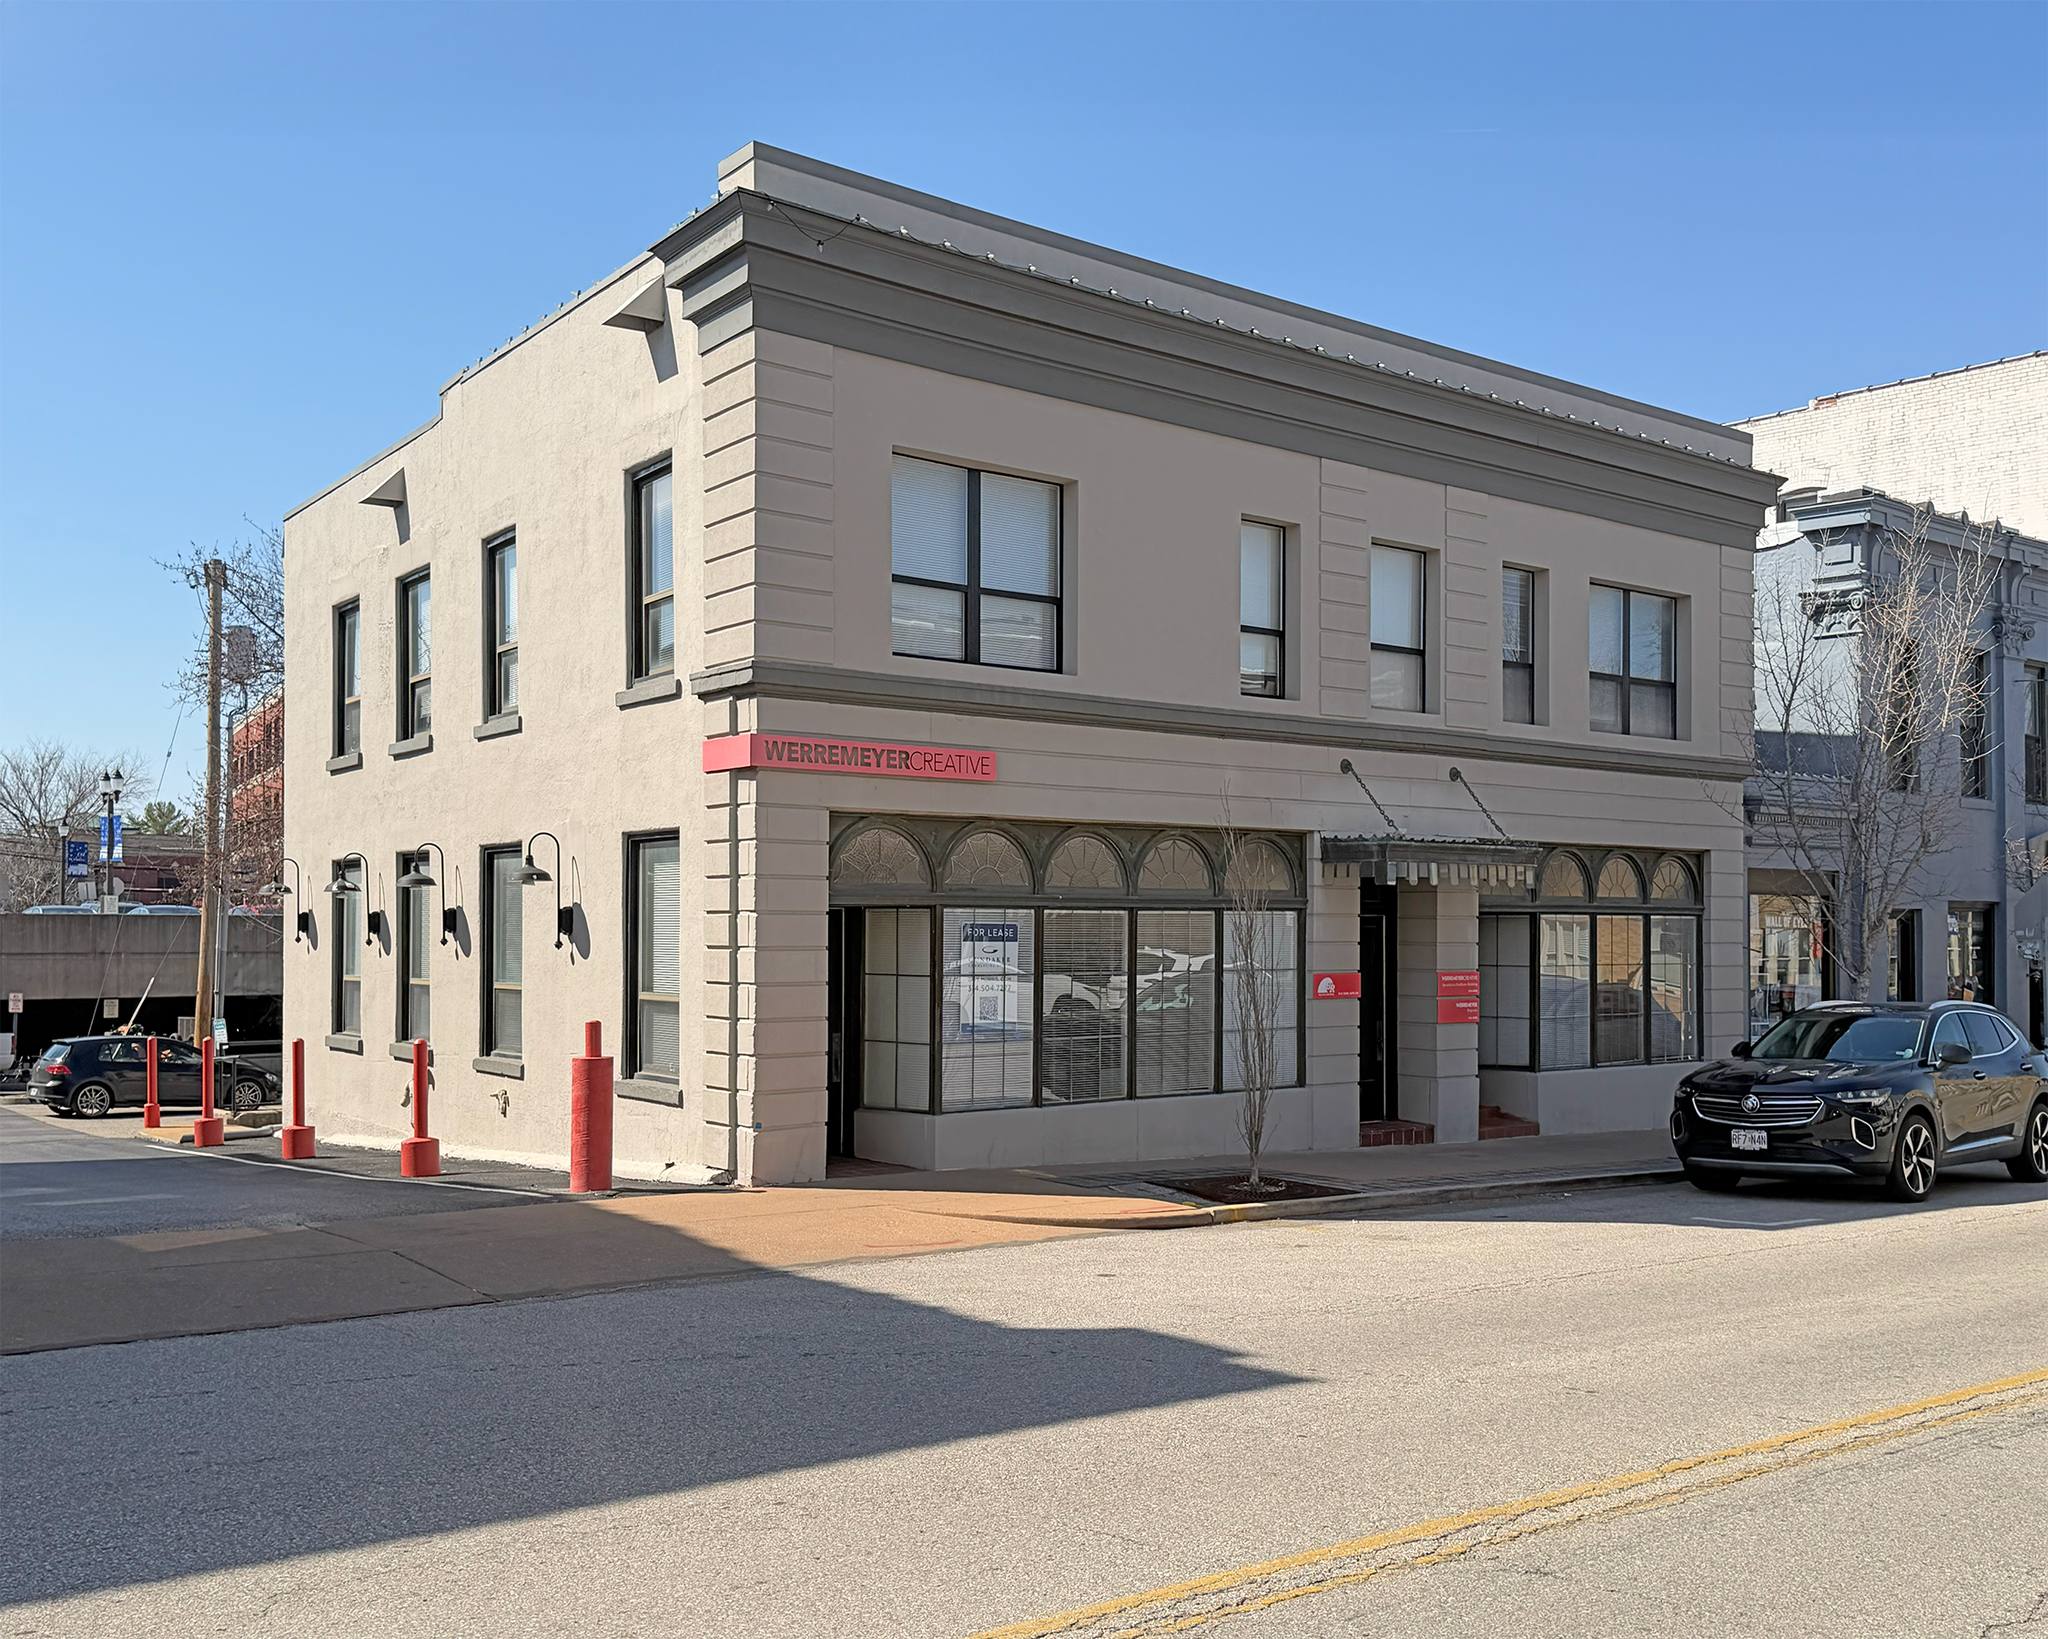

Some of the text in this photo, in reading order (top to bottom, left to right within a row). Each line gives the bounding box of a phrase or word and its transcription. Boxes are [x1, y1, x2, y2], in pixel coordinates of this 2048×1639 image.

[764, 740, 990, 775] WERREMEYERCREATIVE
[967, 928, 1014, 937] FOR LEASE
